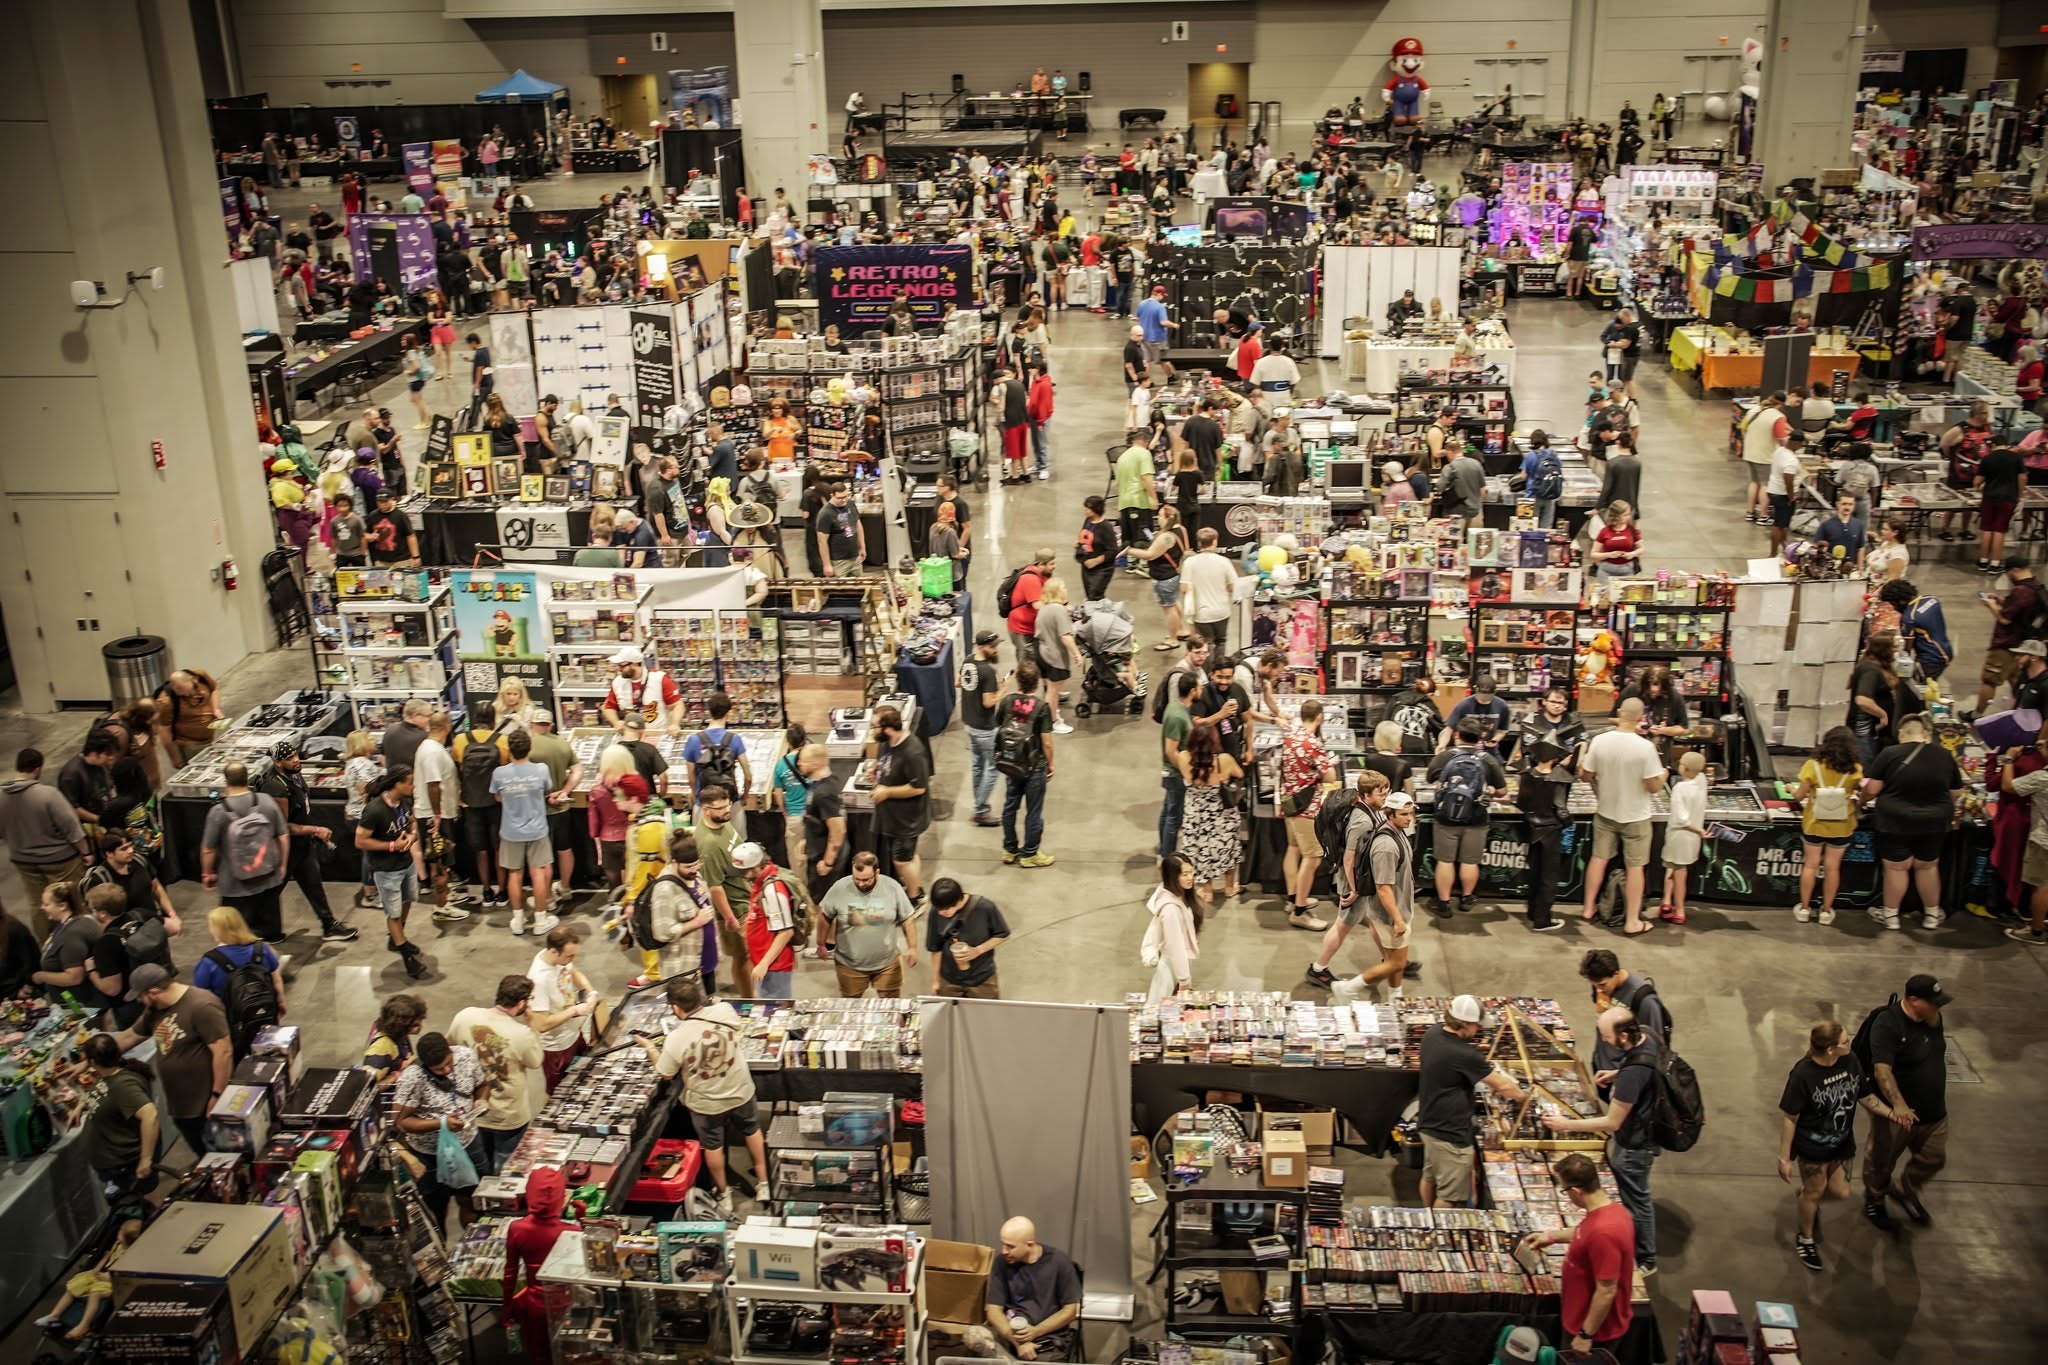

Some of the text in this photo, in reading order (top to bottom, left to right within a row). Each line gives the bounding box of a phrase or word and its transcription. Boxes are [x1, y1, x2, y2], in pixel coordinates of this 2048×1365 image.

[848, 265, 939, 280] RETRO
[831, 282, 958, 299] LEGENDS
[458, 582, 532, 593] VIDEO GAME
[1757, 847, 1788, 862] MR.
[1823, 1071, 1848, 1085] SCREAM
[769, 1252, 792, 1264] Wii
